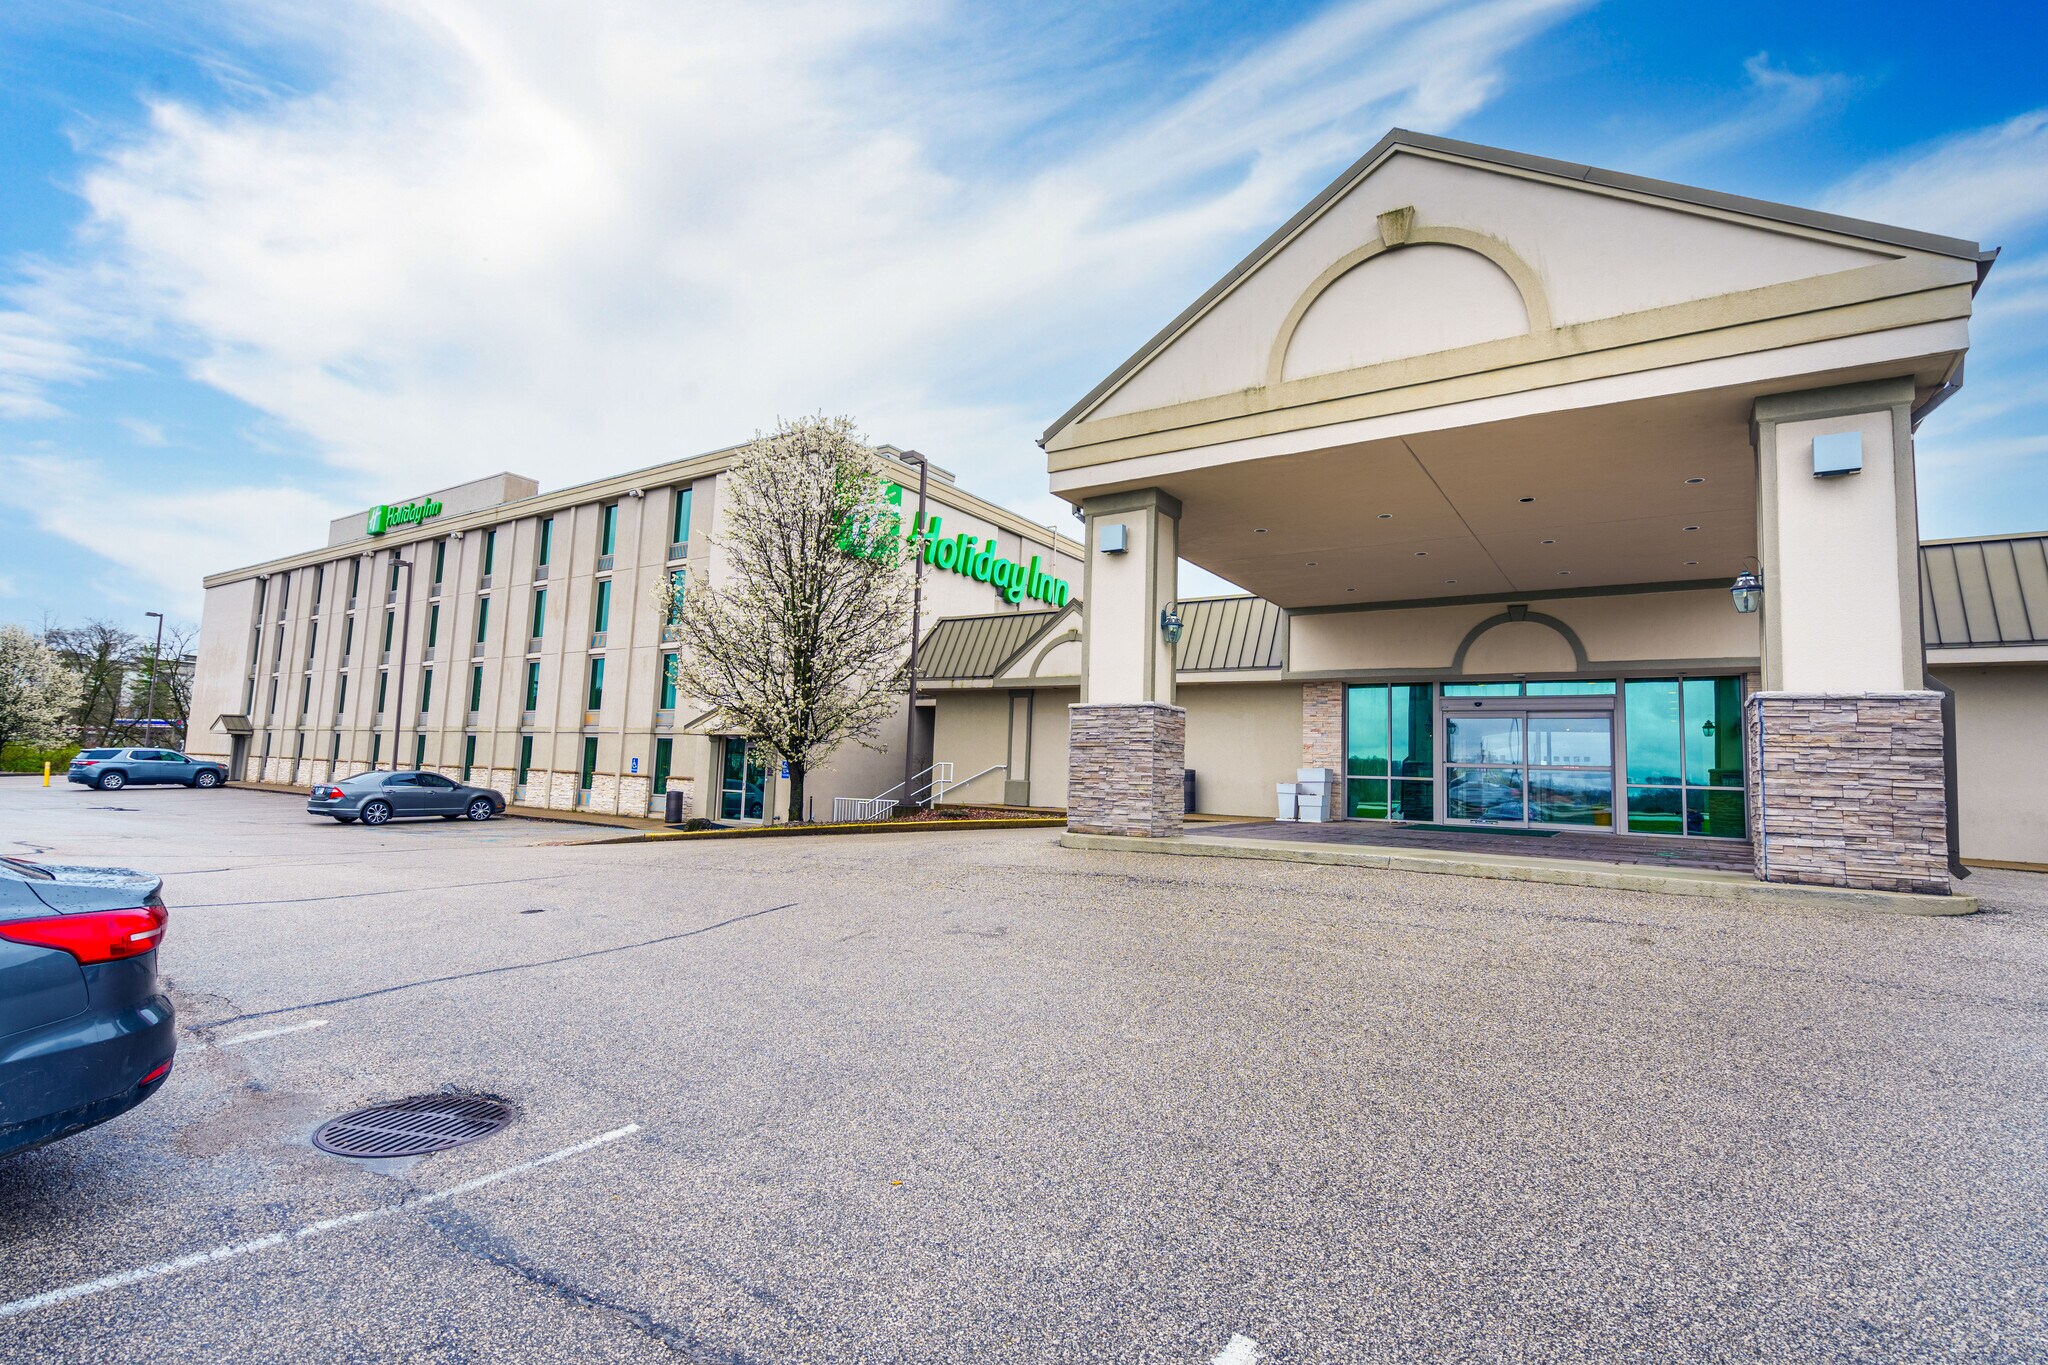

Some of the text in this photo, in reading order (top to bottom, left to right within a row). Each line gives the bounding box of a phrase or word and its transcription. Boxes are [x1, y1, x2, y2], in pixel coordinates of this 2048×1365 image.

[386, 497, 442, 525] Holiday Inn
[907, 511, 1028, 604] Holiday
[1027, 555, 1069, 607] Inn
